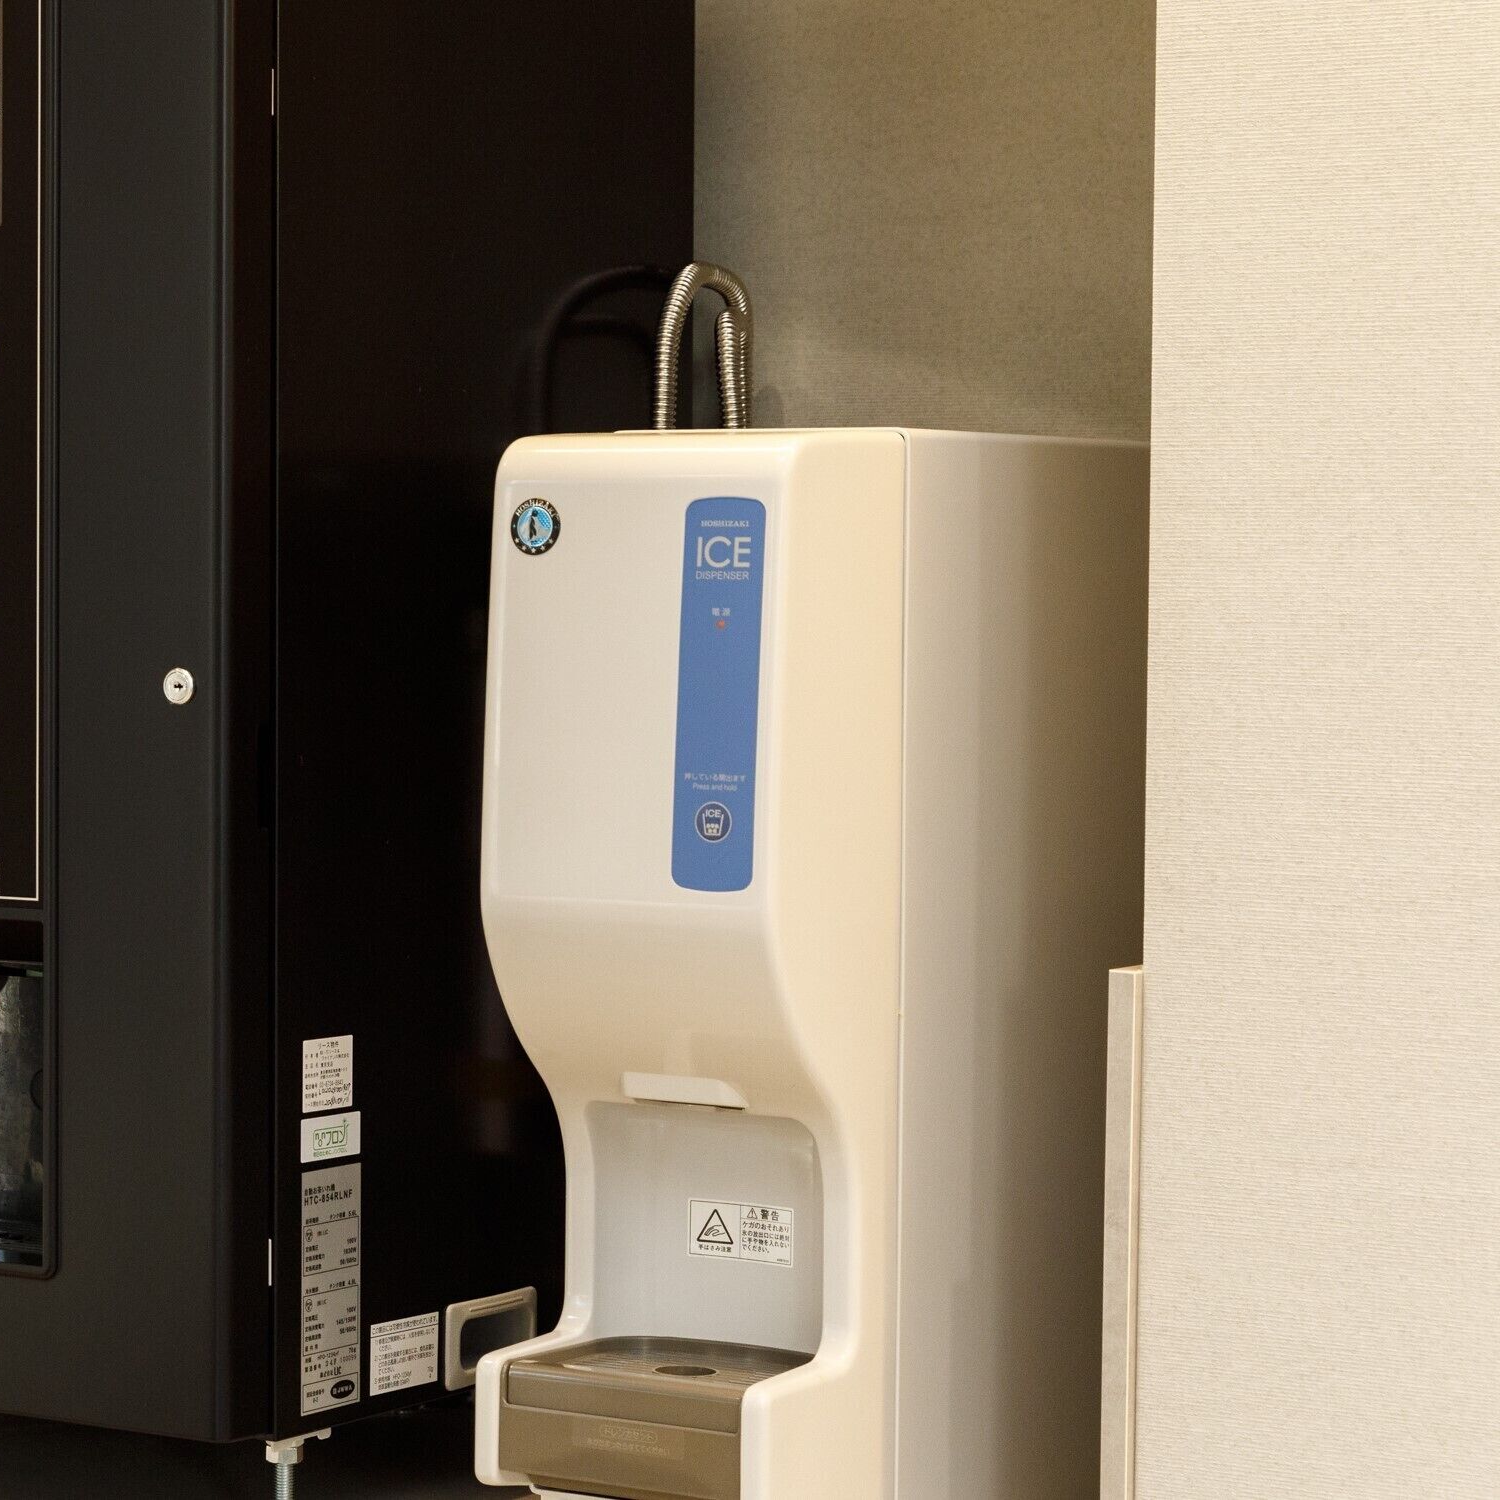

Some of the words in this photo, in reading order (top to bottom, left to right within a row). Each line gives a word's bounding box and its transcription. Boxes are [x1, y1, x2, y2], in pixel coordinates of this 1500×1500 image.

[701, 520, 750, 528] HOSHIZAKI
[696, 535, 752, 568] ICE
[695, 570, 750, 580] DISPENSER
[705, 809, 722, 818] ICE
[304, 1189, 353, 1206] HTC-854RLNF
[761, 1209, 779, 1221] 警告
